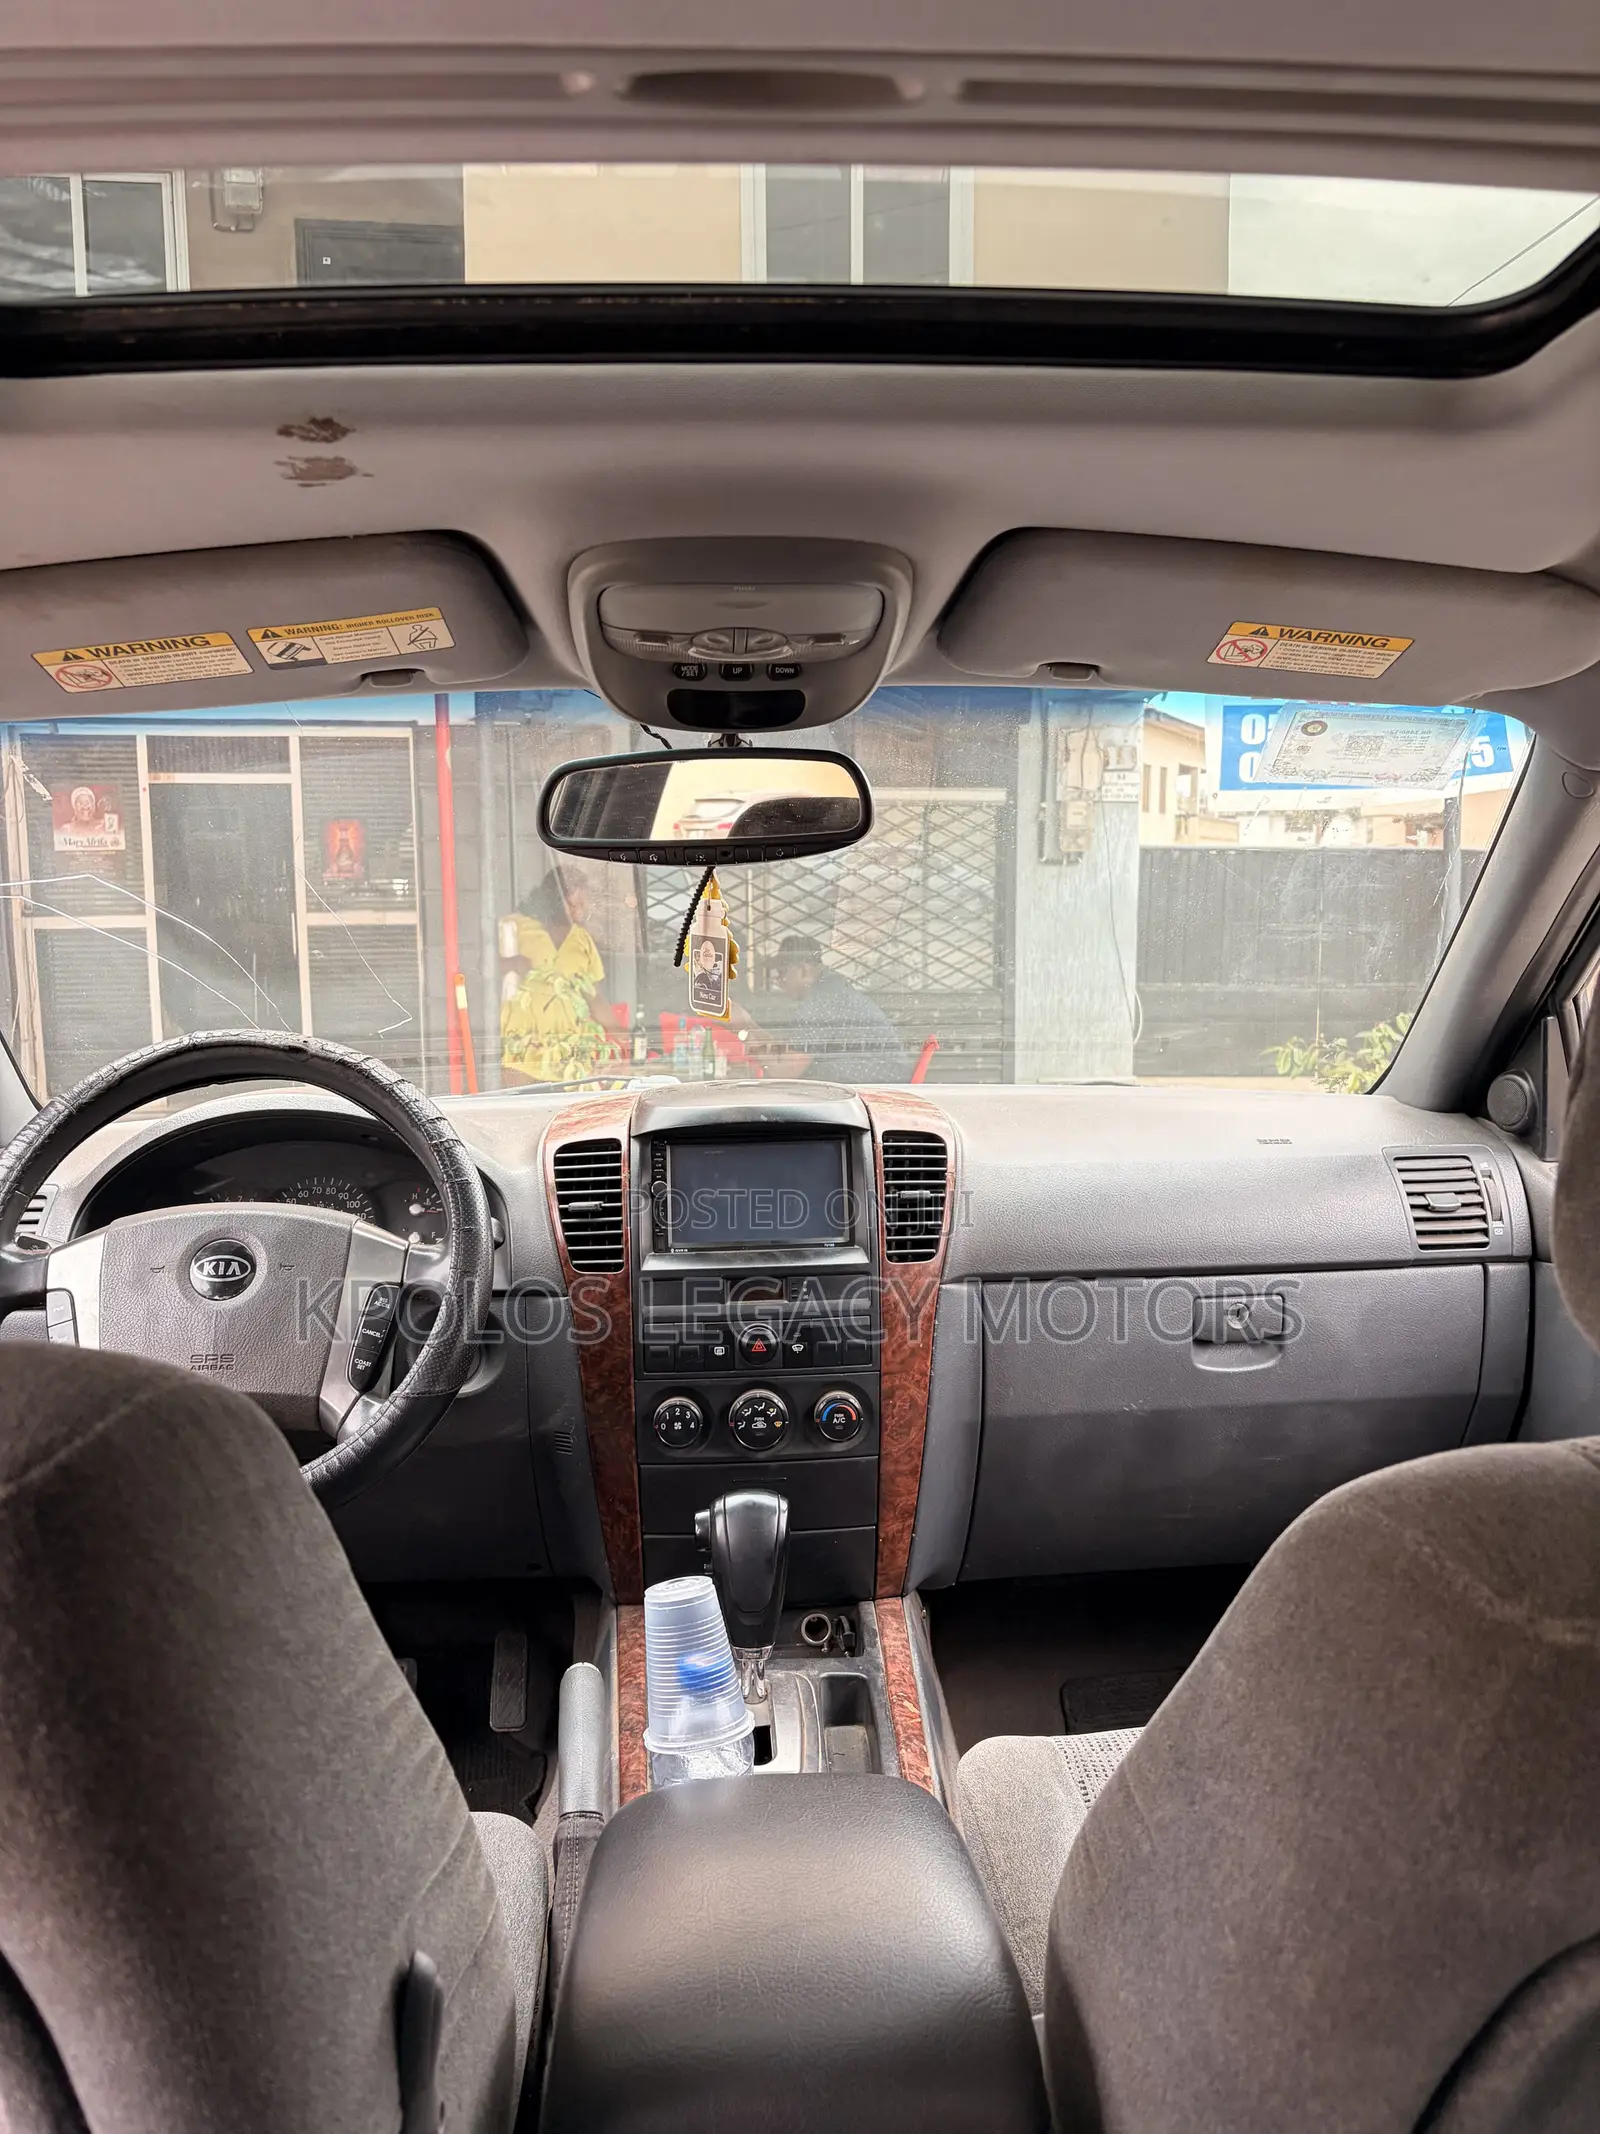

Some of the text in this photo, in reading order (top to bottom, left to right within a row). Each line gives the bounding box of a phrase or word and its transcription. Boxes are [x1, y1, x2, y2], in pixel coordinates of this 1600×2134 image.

[284, 623, 344, 637] WARNING:
[1278, 628, 1391, 648] WARNING
[86, 636, 211, 659] WARNING
[298, 1190, 309, 1198] 60
[311, 1187, 322, 1195] 70
[325, 1187, 336, 1195] 80
[338, 1192, 349, 1200] 90
[346, 1201, 360, 1209] 100
[202, 1261, 242, 1276] KIA
[362, 1328, 381, 1338] CANCEL
[190, 1354, 236, 1364] SRS
[675, 1408, 680, 1416] 2
[686, 1411, 691, 1419] 3
[832, 1416, 846, 1424] A/C
